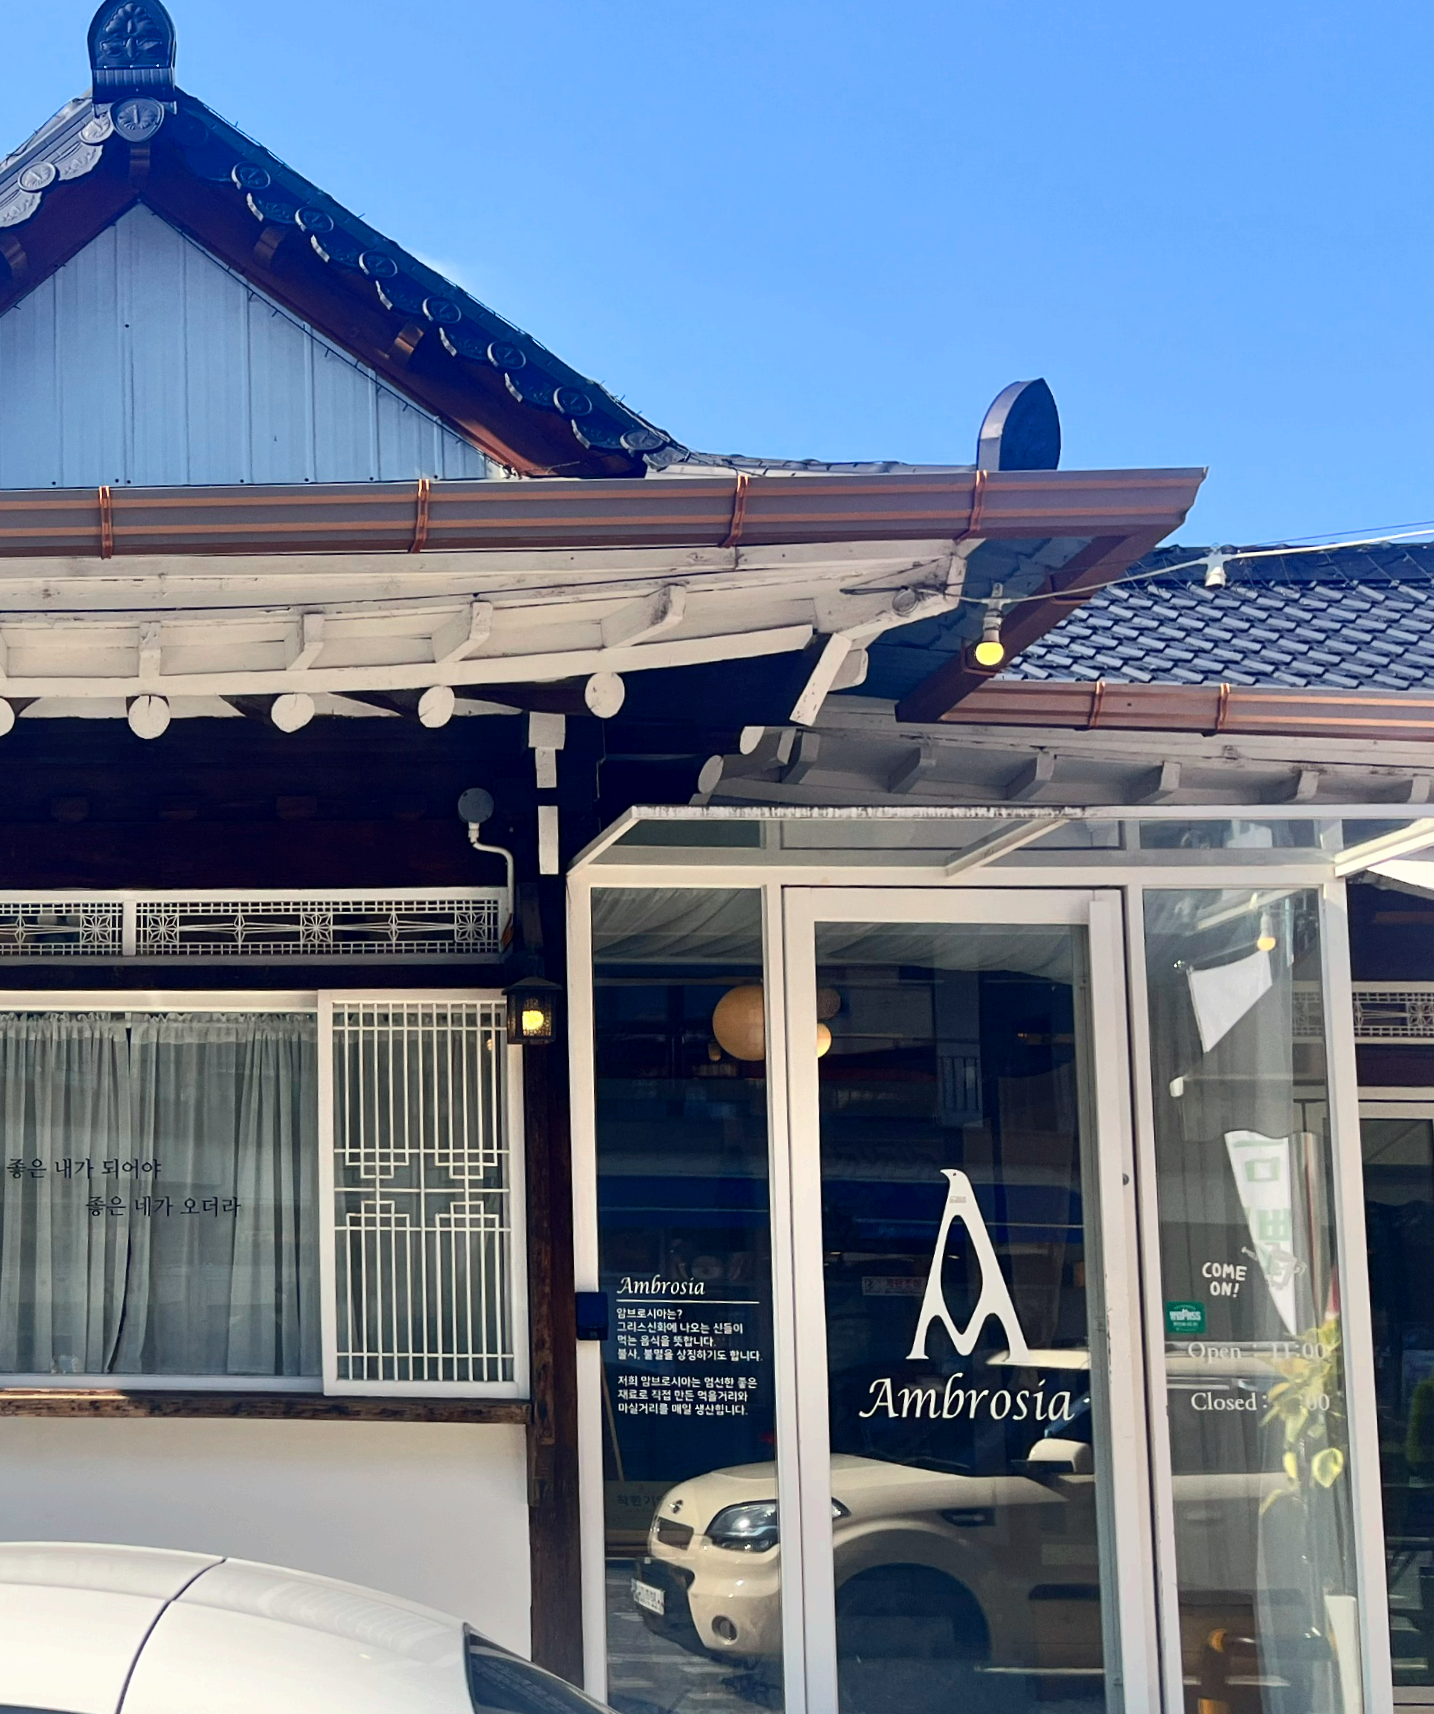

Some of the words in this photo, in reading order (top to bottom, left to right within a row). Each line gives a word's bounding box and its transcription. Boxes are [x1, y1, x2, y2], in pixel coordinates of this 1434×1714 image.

[6, 1157, 47, 1179] 좋은
[55, 1157, 94, 1179] 내가
[101, 1157, 162, 1180] 되어야
[85, 1195, 126, 1217] 좋은
[135, 1195, 174, 1217] 네가
[180, 1196, 241, 1218] 오더라
[1202, 1262, 1248, 1281] COME
[616, 1274, 706, 1295] Ambrosia
[1209, 1281, 1239, 1298] ON!
[616, 1307, 683, 1320] 암브로시아는?
[616, 1321, 678, 1333] 그리스신화에
[679, 1322, 710, 1334] 나오는
[713, 1322, 744, 1335] 신들이
[617, 1335, 638, 1346] 먹는
[640, 1335, 670, 1347] 음식을
[673, 1335, 716, 1347] 뜻합니다.
[676, 1349, 728, 1361] 상징하기도
[729, 1350, 764, 1362] 합니다.
[1187, 1341, 1242, 1364] Open
[617, 1375, 638, 1387] 저희
[640, 1375, 701, 1388] 암브로시아는
[704, 1376, 735, 1389] 엄선한
[737, 1376, 758, 1389] 좋은
[617, 1389, 649, 1400] 재료로
[651, 1389, 672, 1401] 직접
[674, 1390, 695, 1401] 만든
[858, 1372, 1076, 1421] Ambrosia
[1190, 1391, 1258, 1411] Closed
[671, 1403, 692, 1415] 매일
